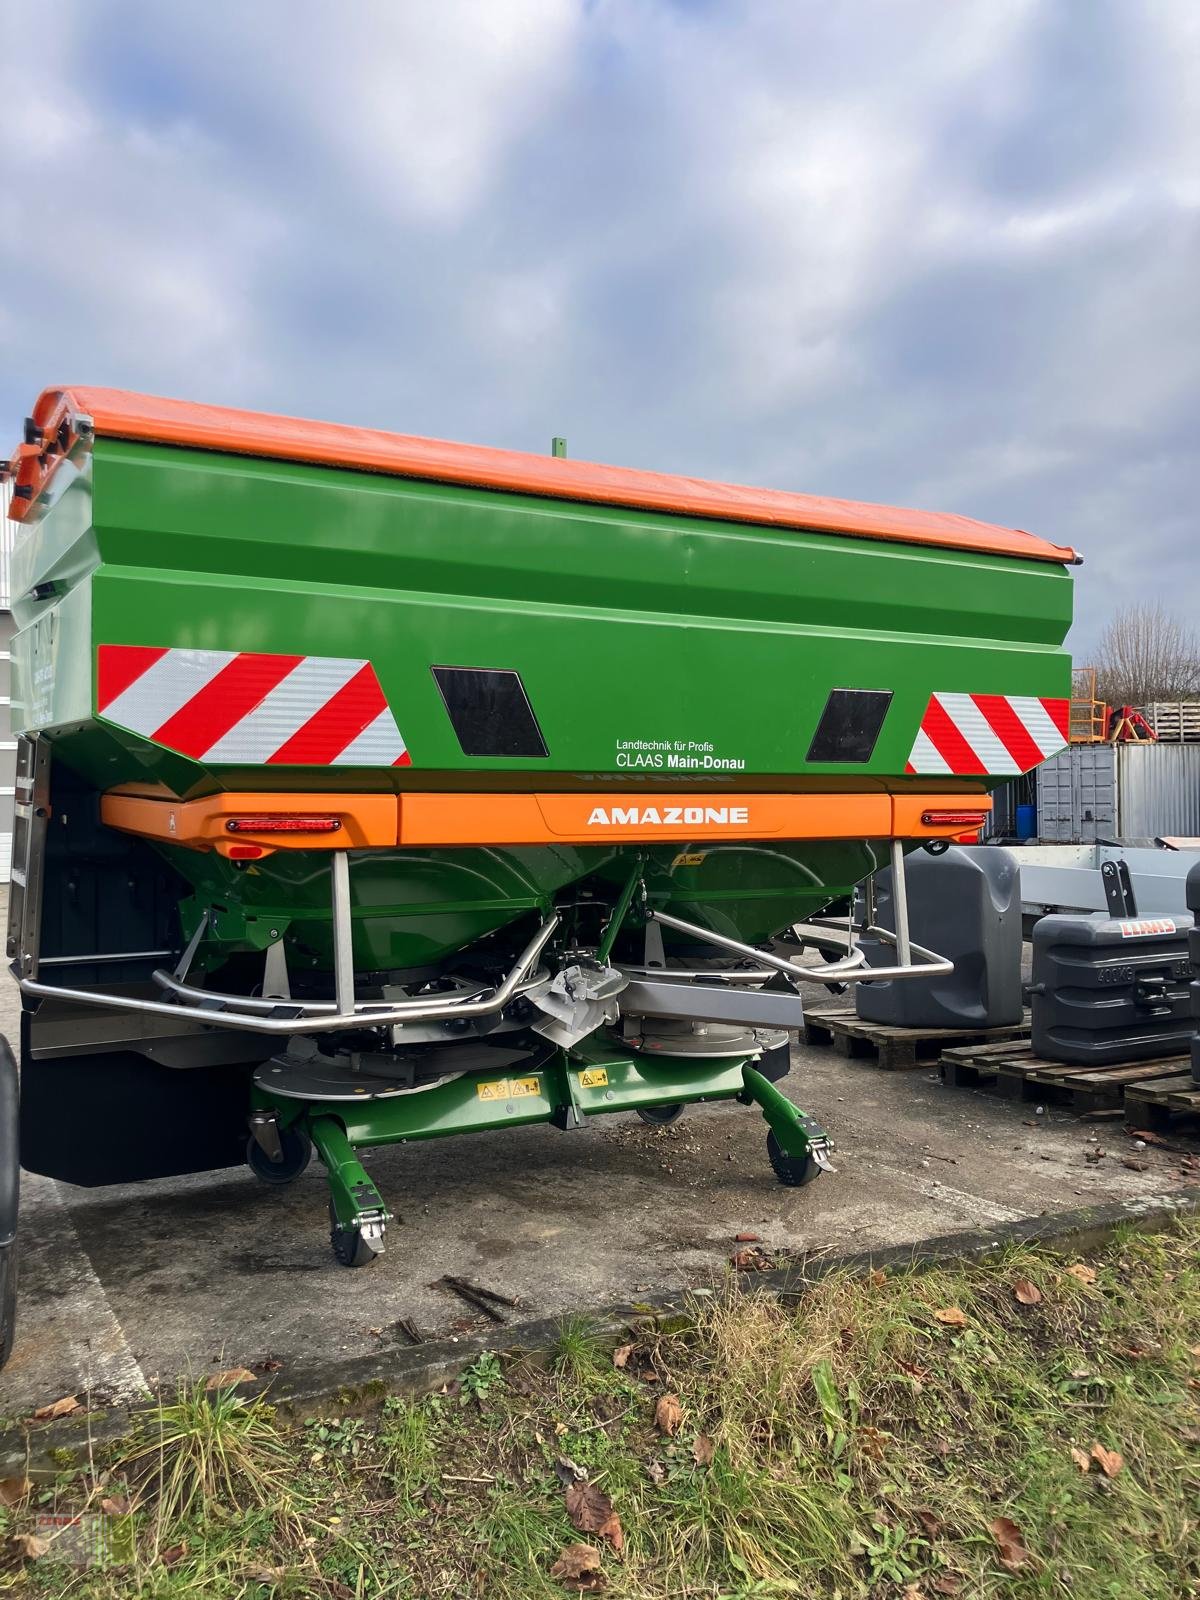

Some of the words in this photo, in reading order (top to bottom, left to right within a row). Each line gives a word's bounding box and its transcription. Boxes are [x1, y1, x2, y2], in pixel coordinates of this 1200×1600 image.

[616, 739, 671, 750] Landtechnik
[673, 741, 686, 751] für
[688, 741, 714, 752] Profis
[616, 753, 663, 767] CLAAS
[667, 754, 745, 769] Main-Donau
[587, 807, 748, 825] AMAZONE
